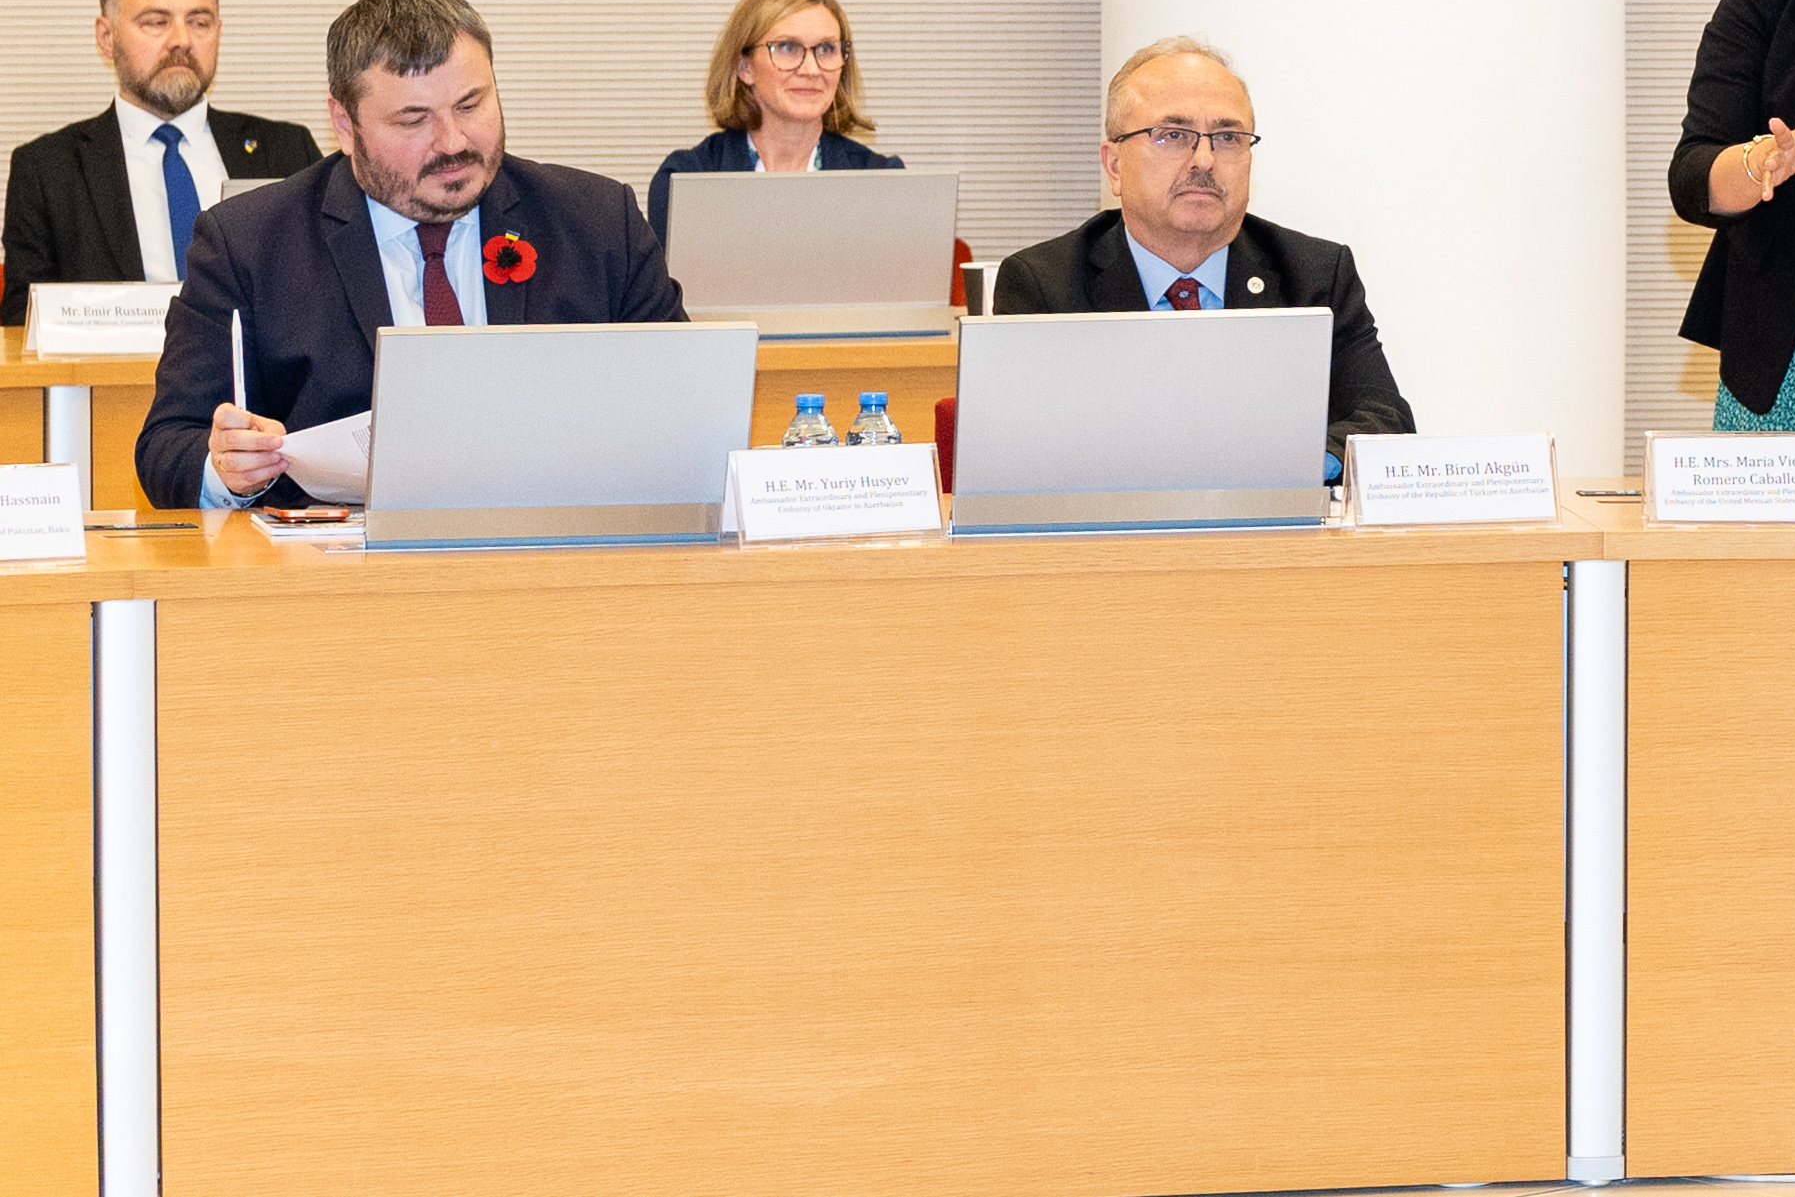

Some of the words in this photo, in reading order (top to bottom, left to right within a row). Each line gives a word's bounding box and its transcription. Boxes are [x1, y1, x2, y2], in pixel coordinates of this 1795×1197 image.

[62, 307, 80, 316] Mr.
[84, 306, 111, 316] Emir
[115, 306, 167, 316] Rustamo
[1674, 457, 1699, 468] H.E.
[1704, 457, 1732, 467] Mrs.
[1737, 456, 1774, 467] Maria
[1386, 466, 1413, 477] H.E.
[1418, 465, 1440, 477] Mr.
[1445, 463, 1479, 475] Birol
[1484, 462, 1529, 476] Akgün
[766, 481, 791, 492] H.E.
[796, 479, 817, 490] Mr.
[821, 478, 856, 491] Yuriy
[861, 476, 909, 490] Husyev
[1693, 474, 1745, 485] Romero
[800, 494, 851, 502] Extraordinary
[870, 489, 927, 498] Plenipotentiary
[1425, 490, 1457, 499] Republic
[1509, 487, 1549, 495] Azerbaijan
[1, 493, 60, 506] Hassnain
[778, 505, 811, 514] Embassy
[864, 501, 903, 509] Azerbaijan
[49, 526, 70, 534] Baku
